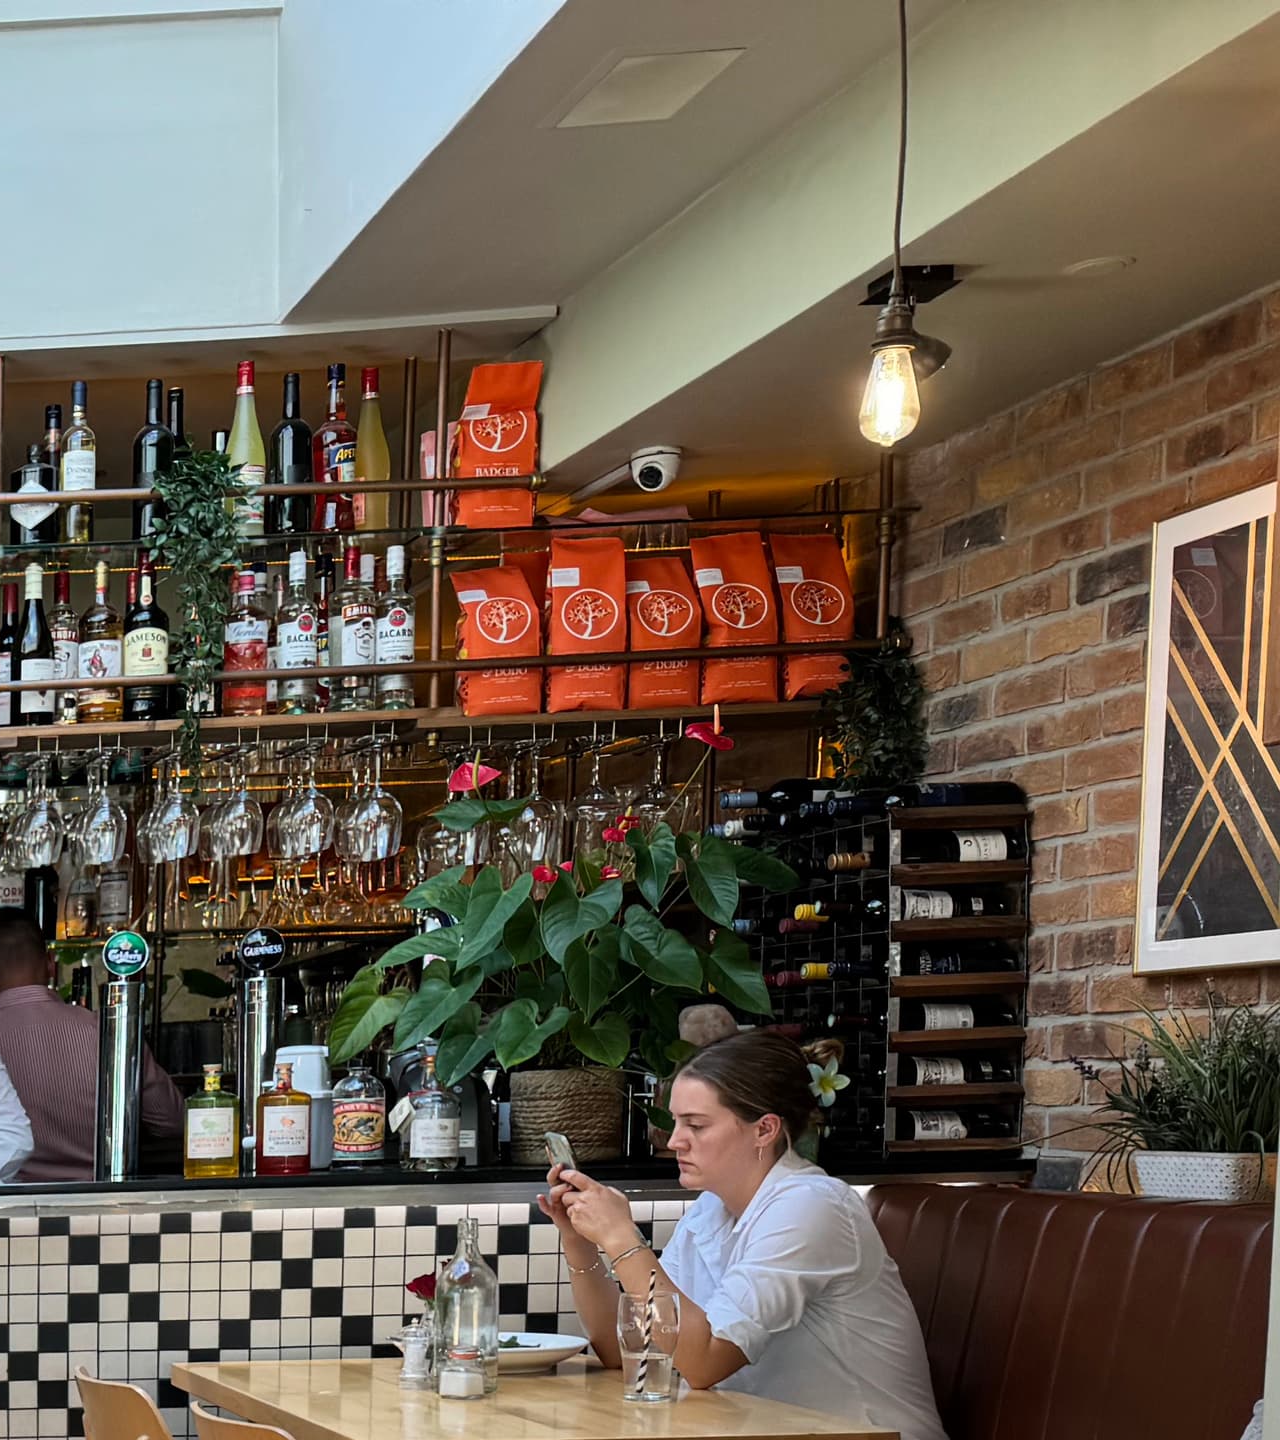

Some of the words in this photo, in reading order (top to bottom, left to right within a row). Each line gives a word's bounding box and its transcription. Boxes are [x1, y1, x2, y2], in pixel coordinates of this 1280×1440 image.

[335, 447, 355, 463] APE
[475, 467, 520, 478] BADGER
[126, 632, 167, 647] JAMESON
[243, 944, 282, 957] GUINNESS
